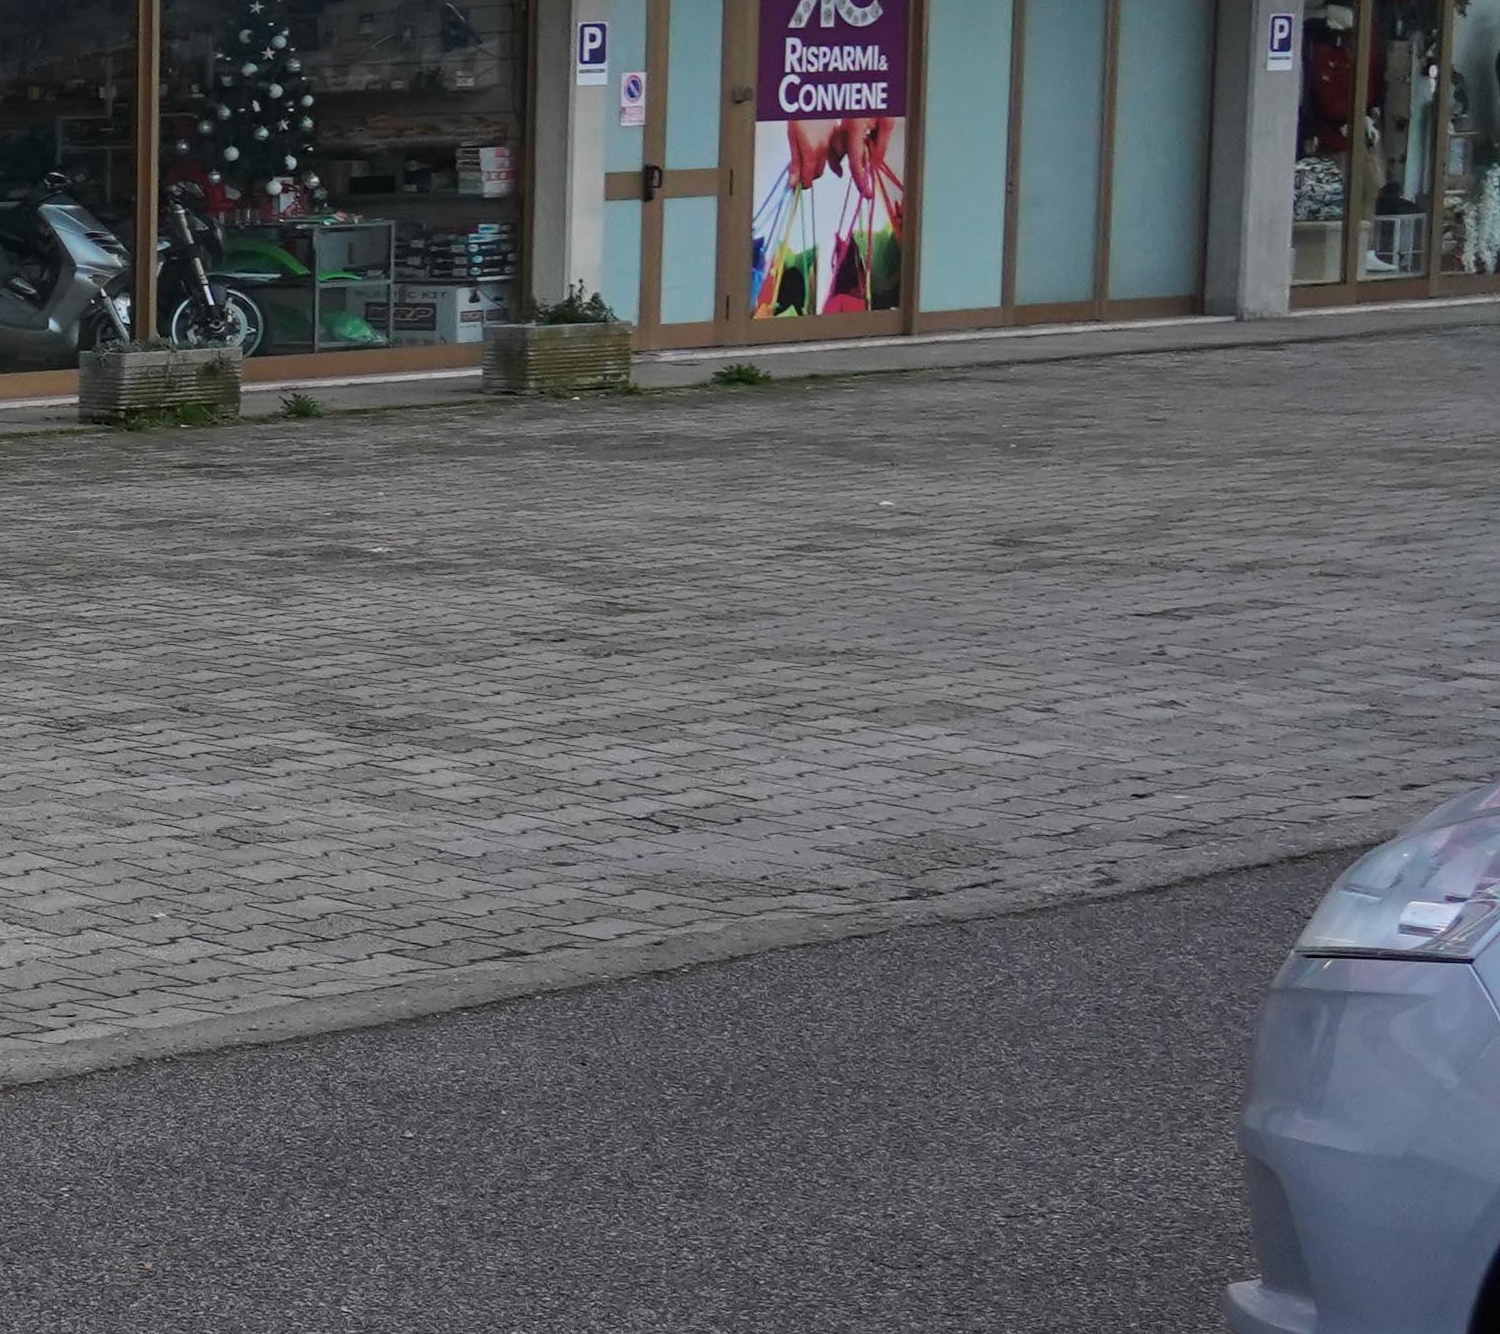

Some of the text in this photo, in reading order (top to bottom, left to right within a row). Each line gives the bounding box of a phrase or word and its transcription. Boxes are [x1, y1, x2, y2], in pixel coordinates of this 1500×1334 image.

[583, 26, 602, 62] P
[1273, 18, 1289, 49] P
[778, 74, 888, 113] CONVIENE
